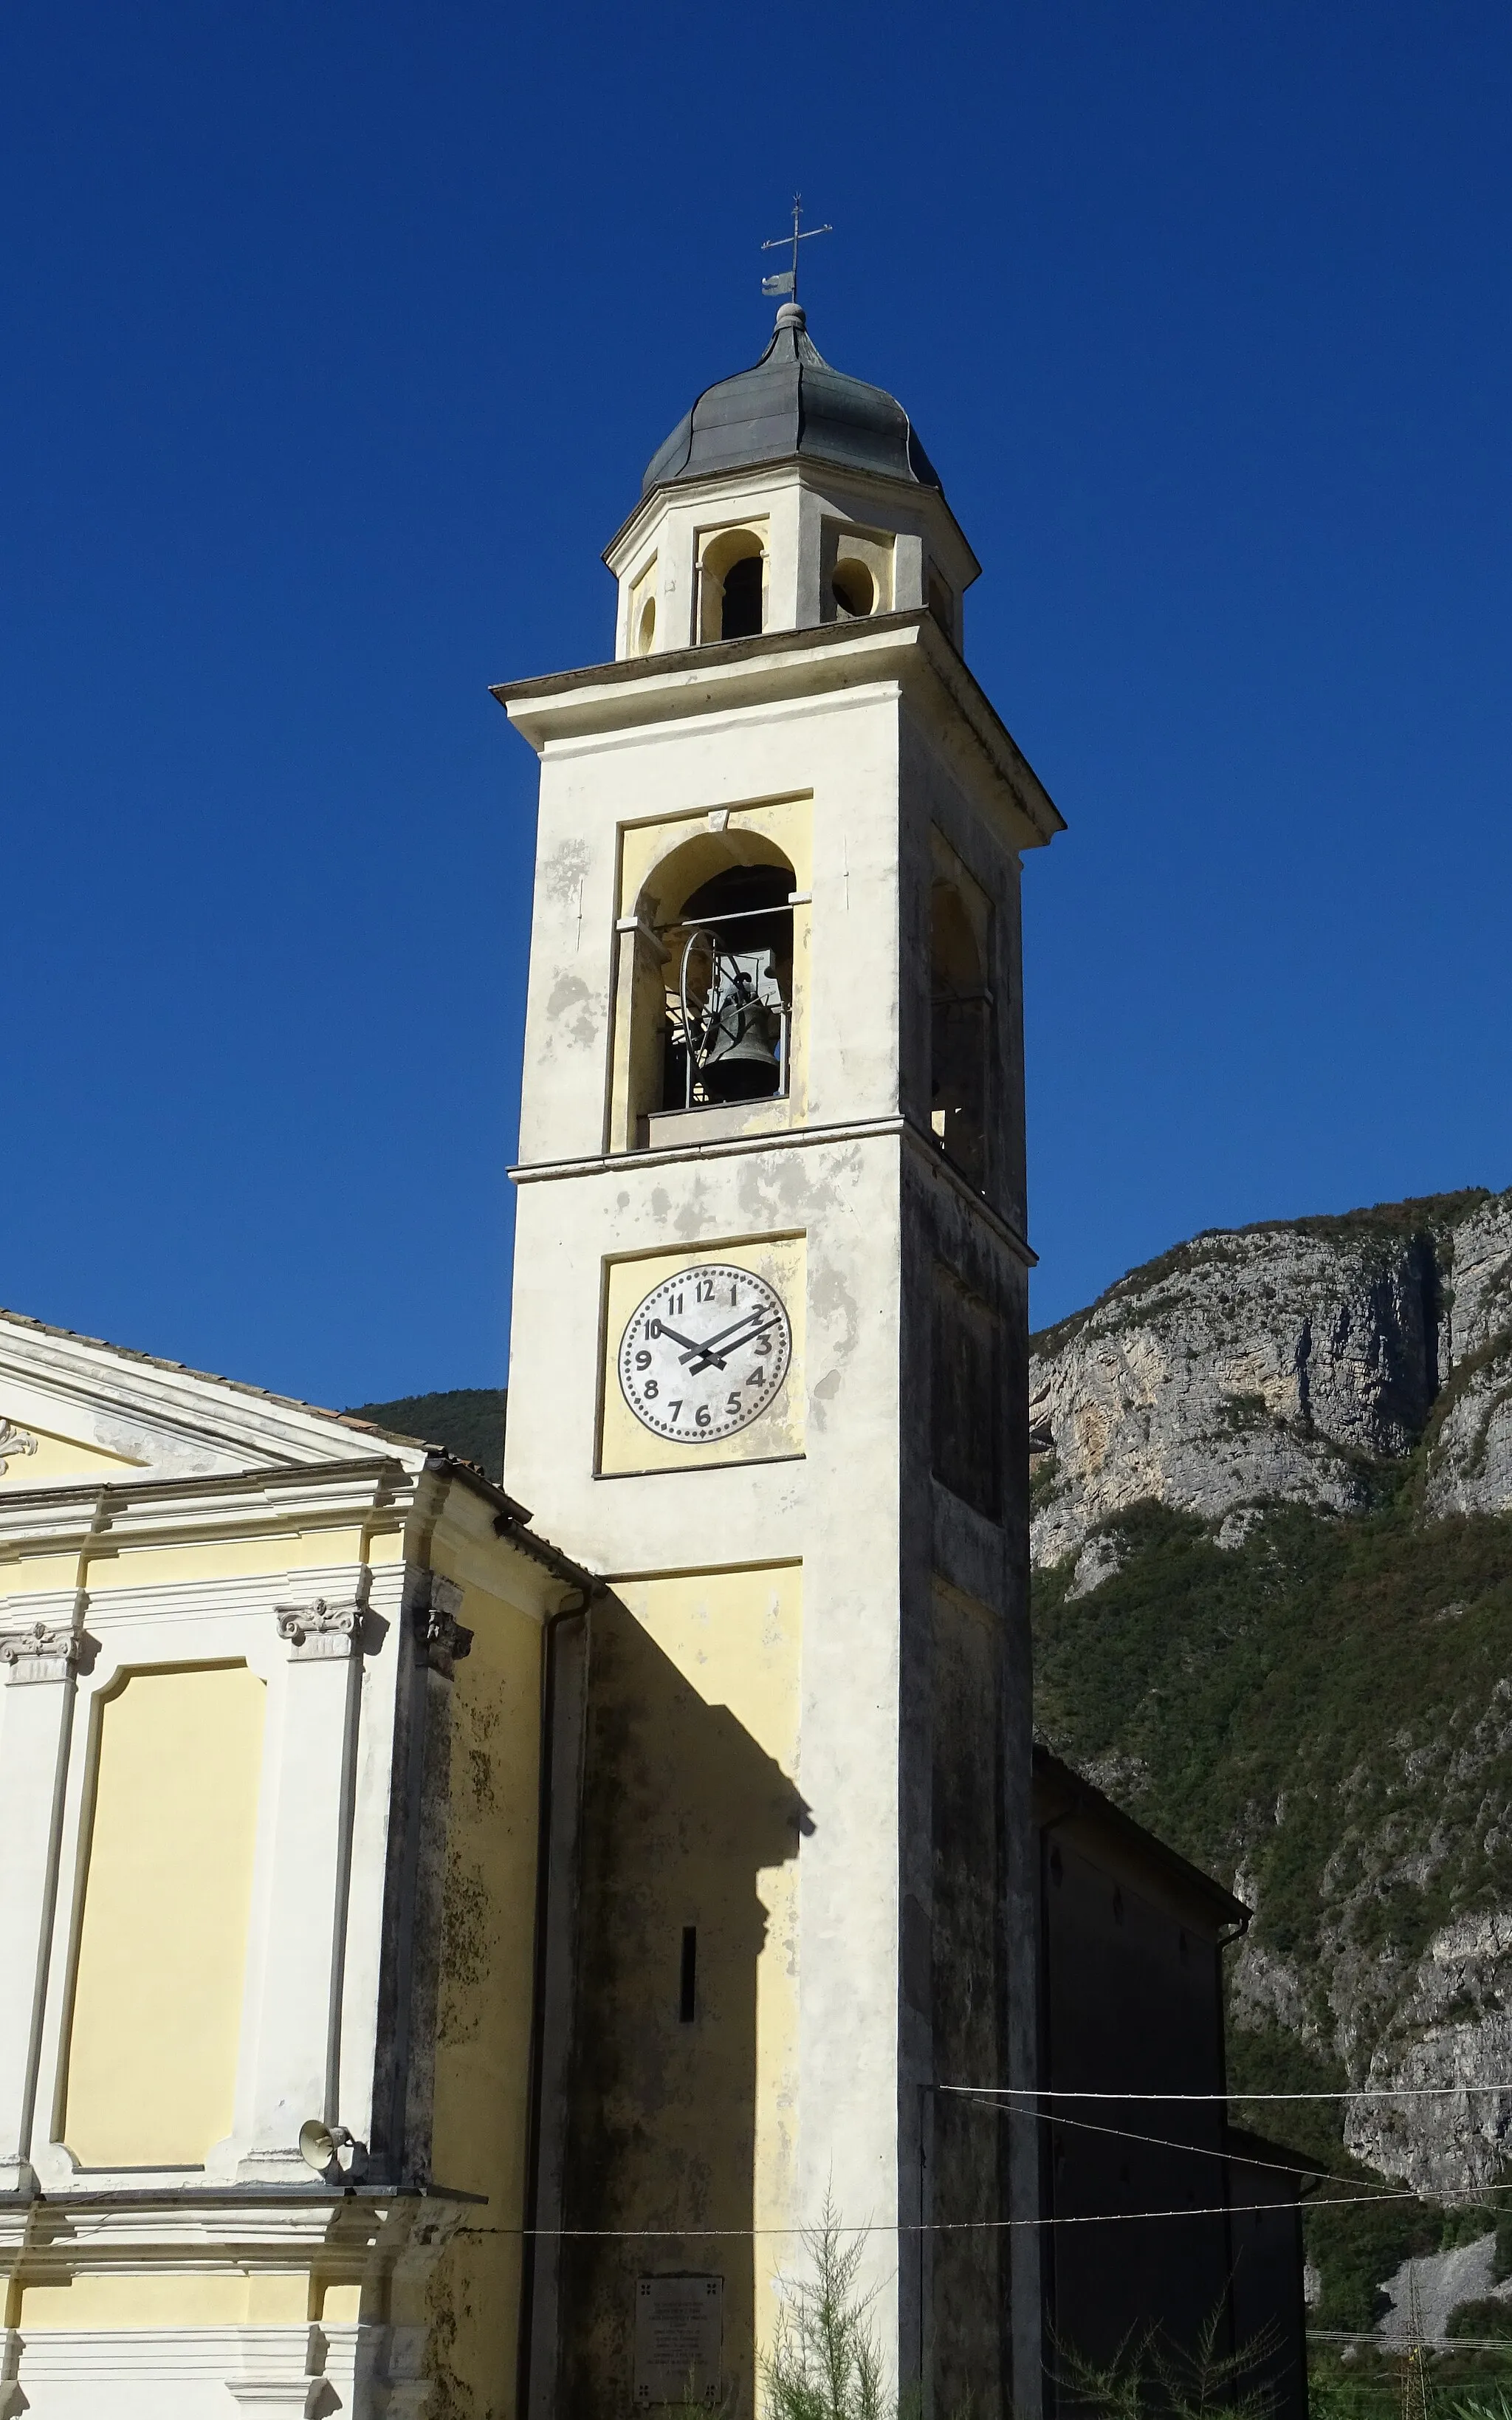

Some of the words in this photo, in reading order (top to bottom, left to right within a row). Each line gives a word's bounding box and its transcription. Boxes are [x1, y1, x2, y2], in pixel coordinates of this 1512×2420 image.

[695, 1279, 715, 1303] 12
[730, 1284, 737, 1306] 1
[668, 1293, 683, 1315] 11
[750, 1304, 764, 1326] 2
[644, 1318, 662, 1340] 10
[754, 1334, 772, 1356] 3
[635, 1350, 651, 1371] 9
[746, 1365, 766, 1388] 4
[644, 1379, 659, 1399] 8
[667, 1400, 683, 1422] 7
[725, 1391, 741, 1415] 5
[695, 1405, 711, 1427] 6
